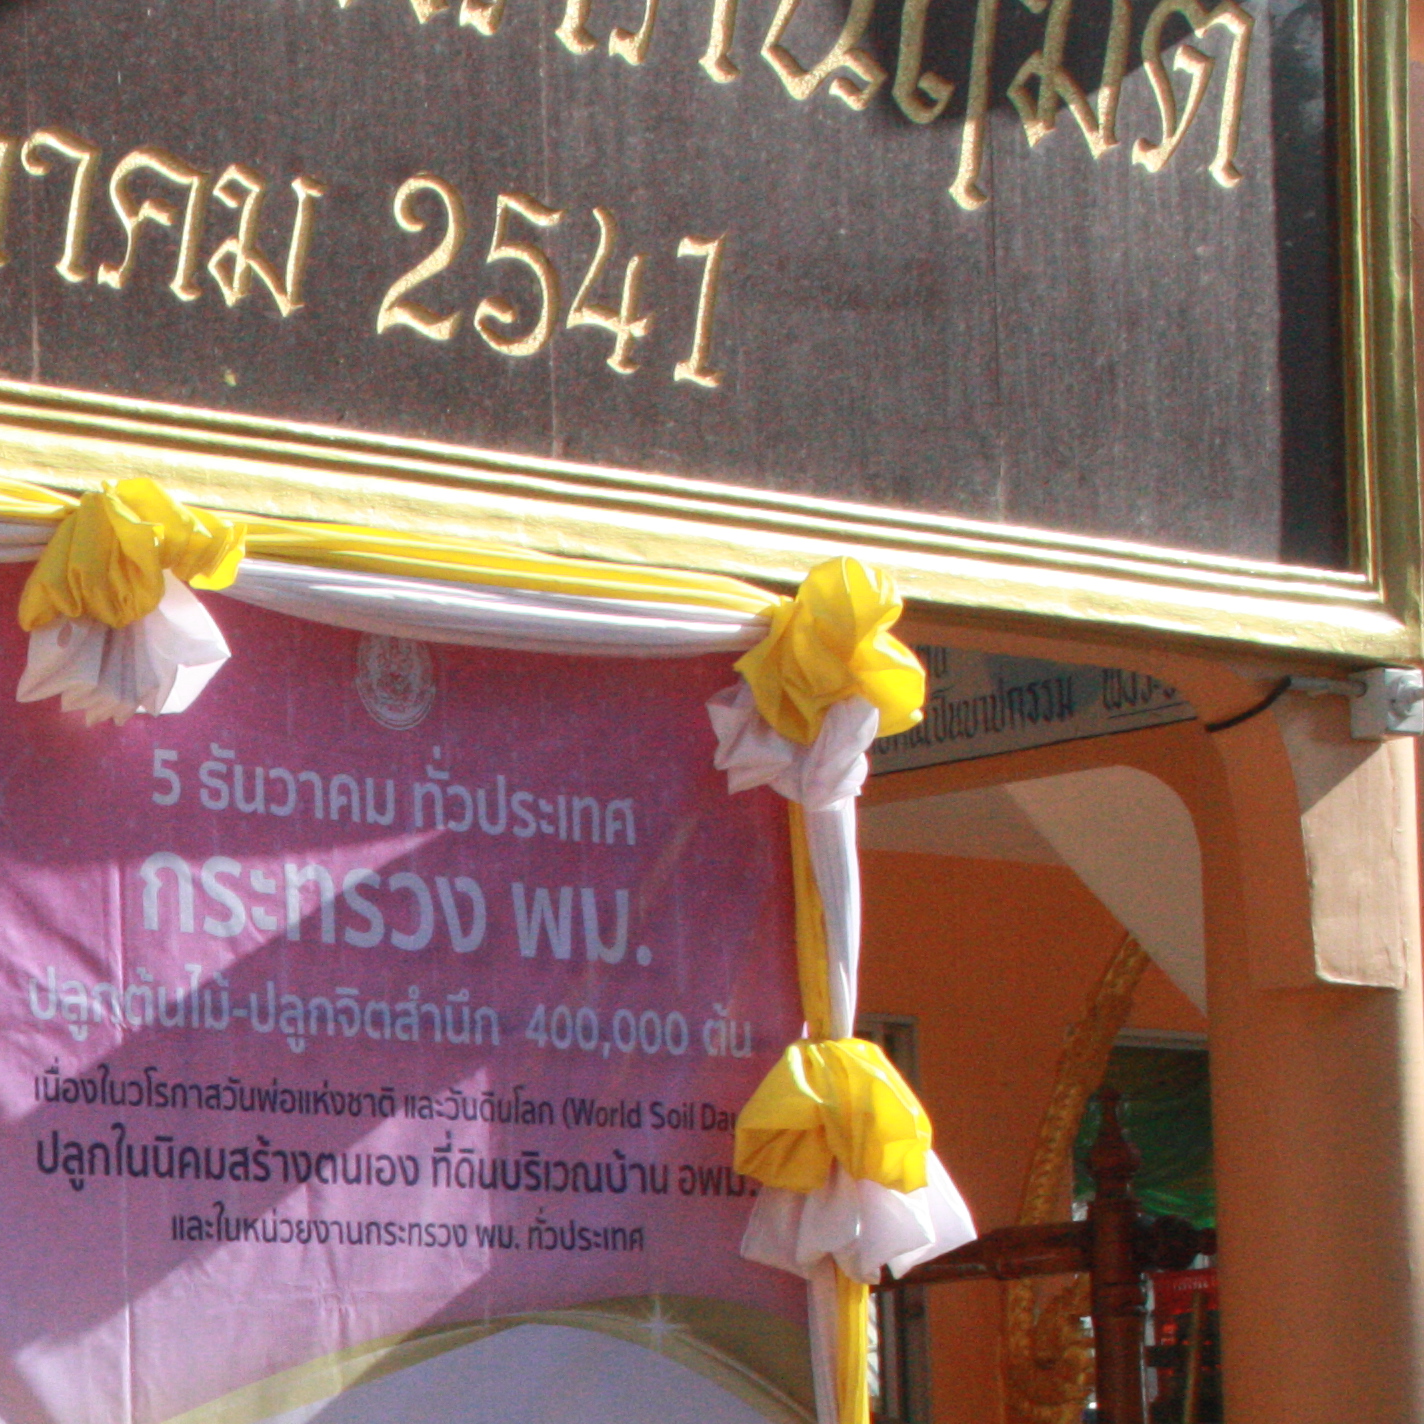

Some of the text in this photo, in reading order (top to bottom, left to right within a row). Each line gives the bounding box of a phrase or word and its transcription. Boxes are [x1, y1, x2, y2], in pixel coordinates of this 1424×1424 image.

[376, 172, 728, 387] 2541
[151, 742, 637, 846] 5 ธันวาคม ทั่วประเทศ
[140, 850, 652, 967] กระทรวง พม.
[28, 962, 752, 1060] ปลูกต้นไม้-ปลูกจิตสำนึก 400,000 ต้น
[34, 1057, 396, 1119] เนื่องในวโรกาสวันพ่อแห่งชาติ
[403, 1083, 554, 1126] และวันดินโลก
[561, 1096, 643, 1130] (World
[650, 1099, 695, 1130] Soil
[36, 1121, 757, 1198] ปลูกในนิคมสร้างตนเอง ที่ดินบริเวณบ้าน อพม.
[171, 1201, 646, 1251] และในหน่วยงานกระทรวง พม. ทั่วประเทศ
